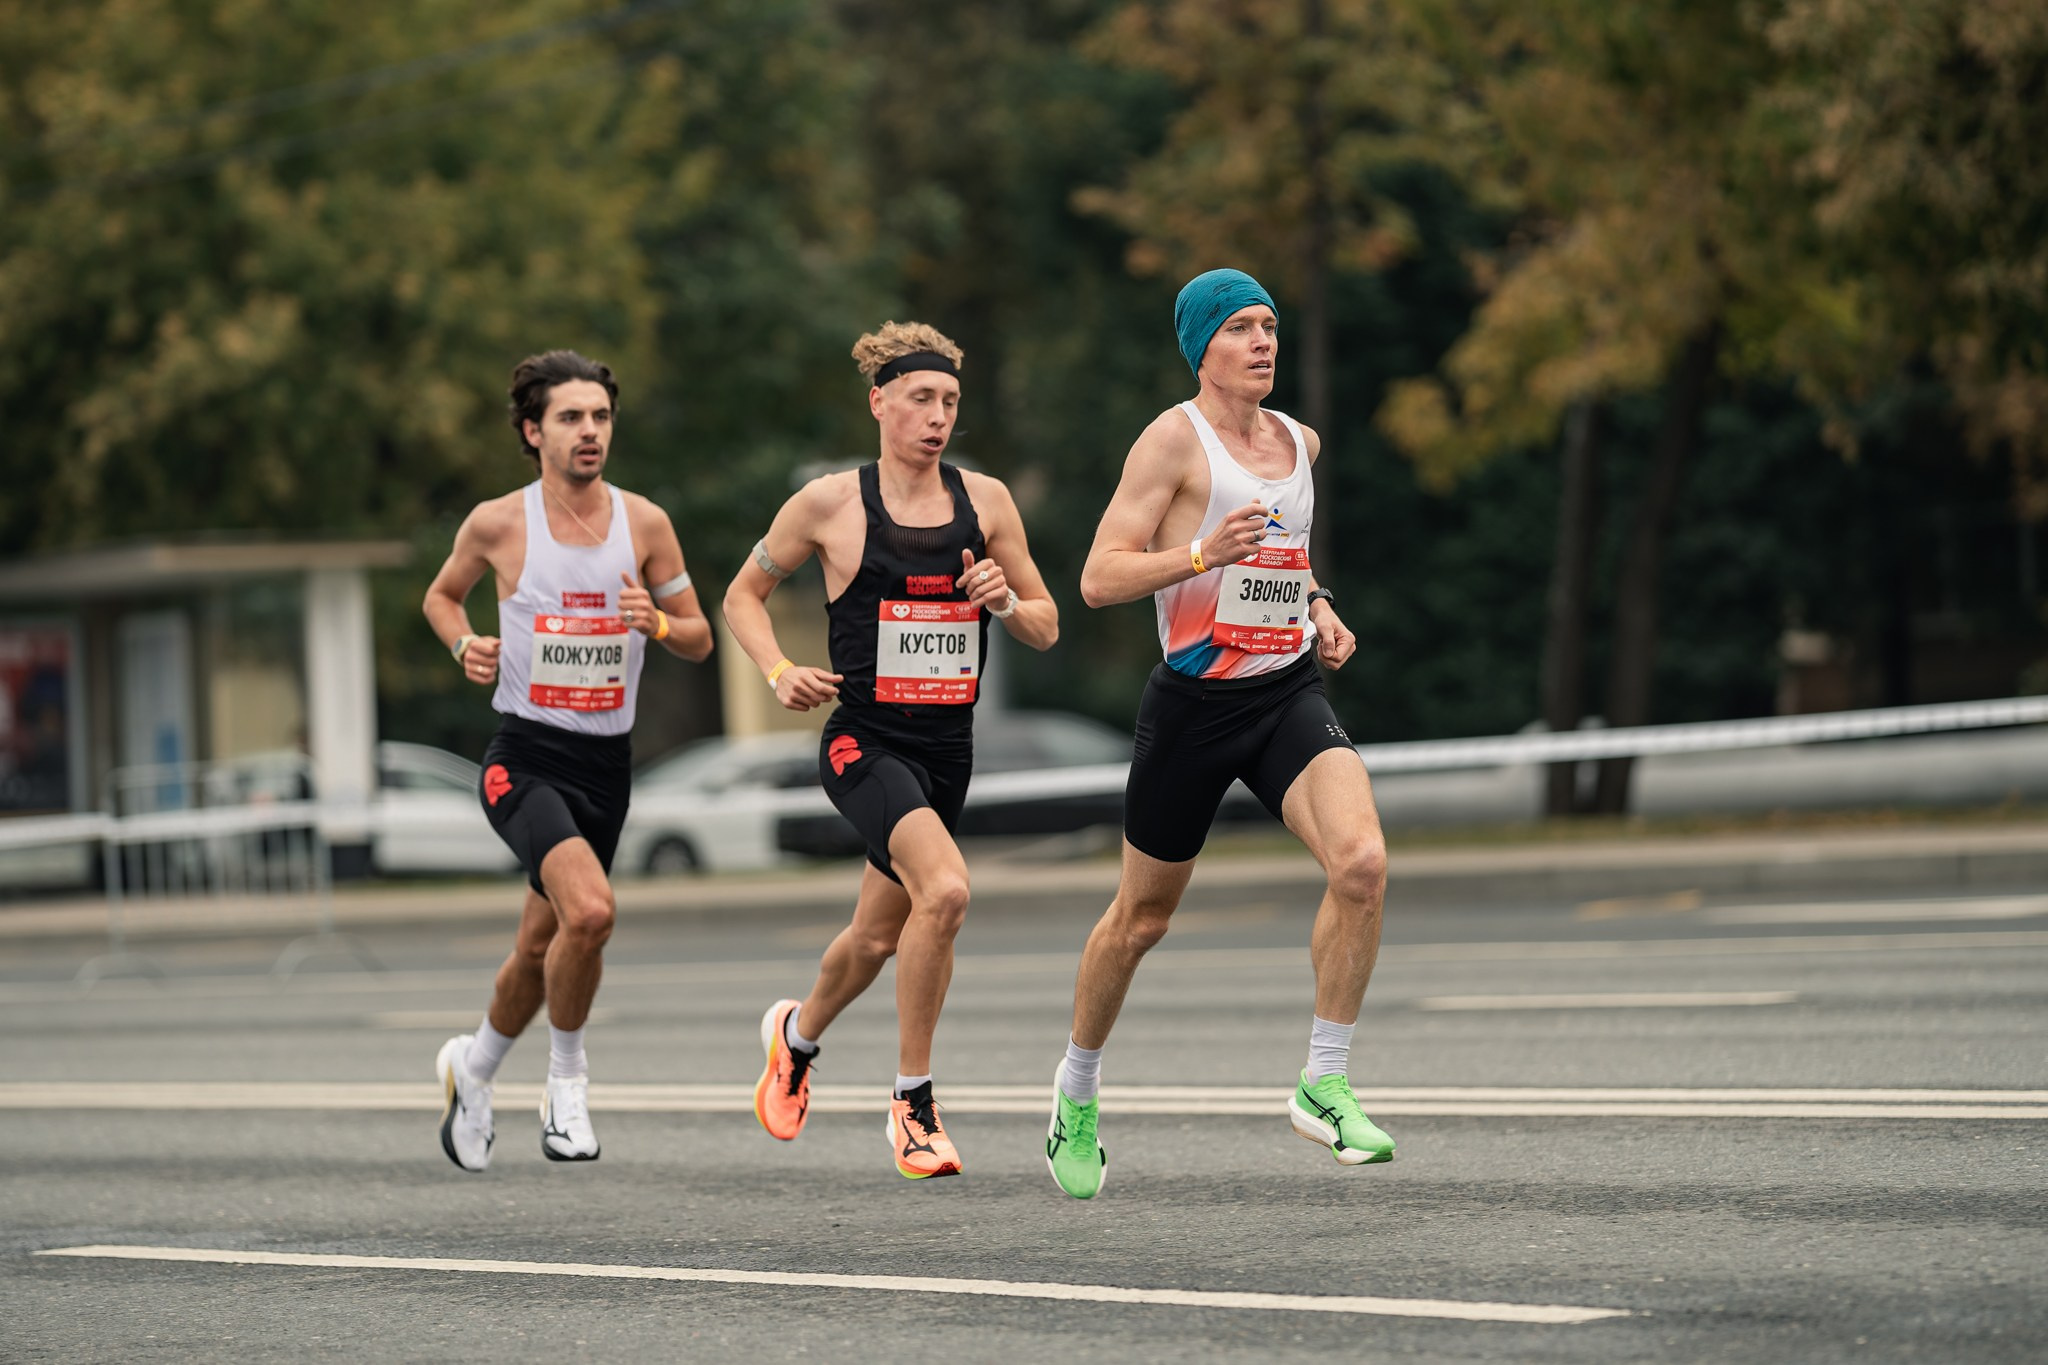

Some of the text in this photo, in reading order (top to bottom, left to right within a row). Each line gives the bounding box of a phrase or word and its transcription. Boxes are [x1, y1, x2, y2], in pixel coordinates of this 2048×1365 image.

[1239, 578, 1301, 604] ЗВОНОВ
[1262, 614, 1271, 623] 26
[900, 633, 967, 654] КУСТОВ
[542, 644, 623, 665] КОЖУХОВ
[929, 666, 940, 675] 18
